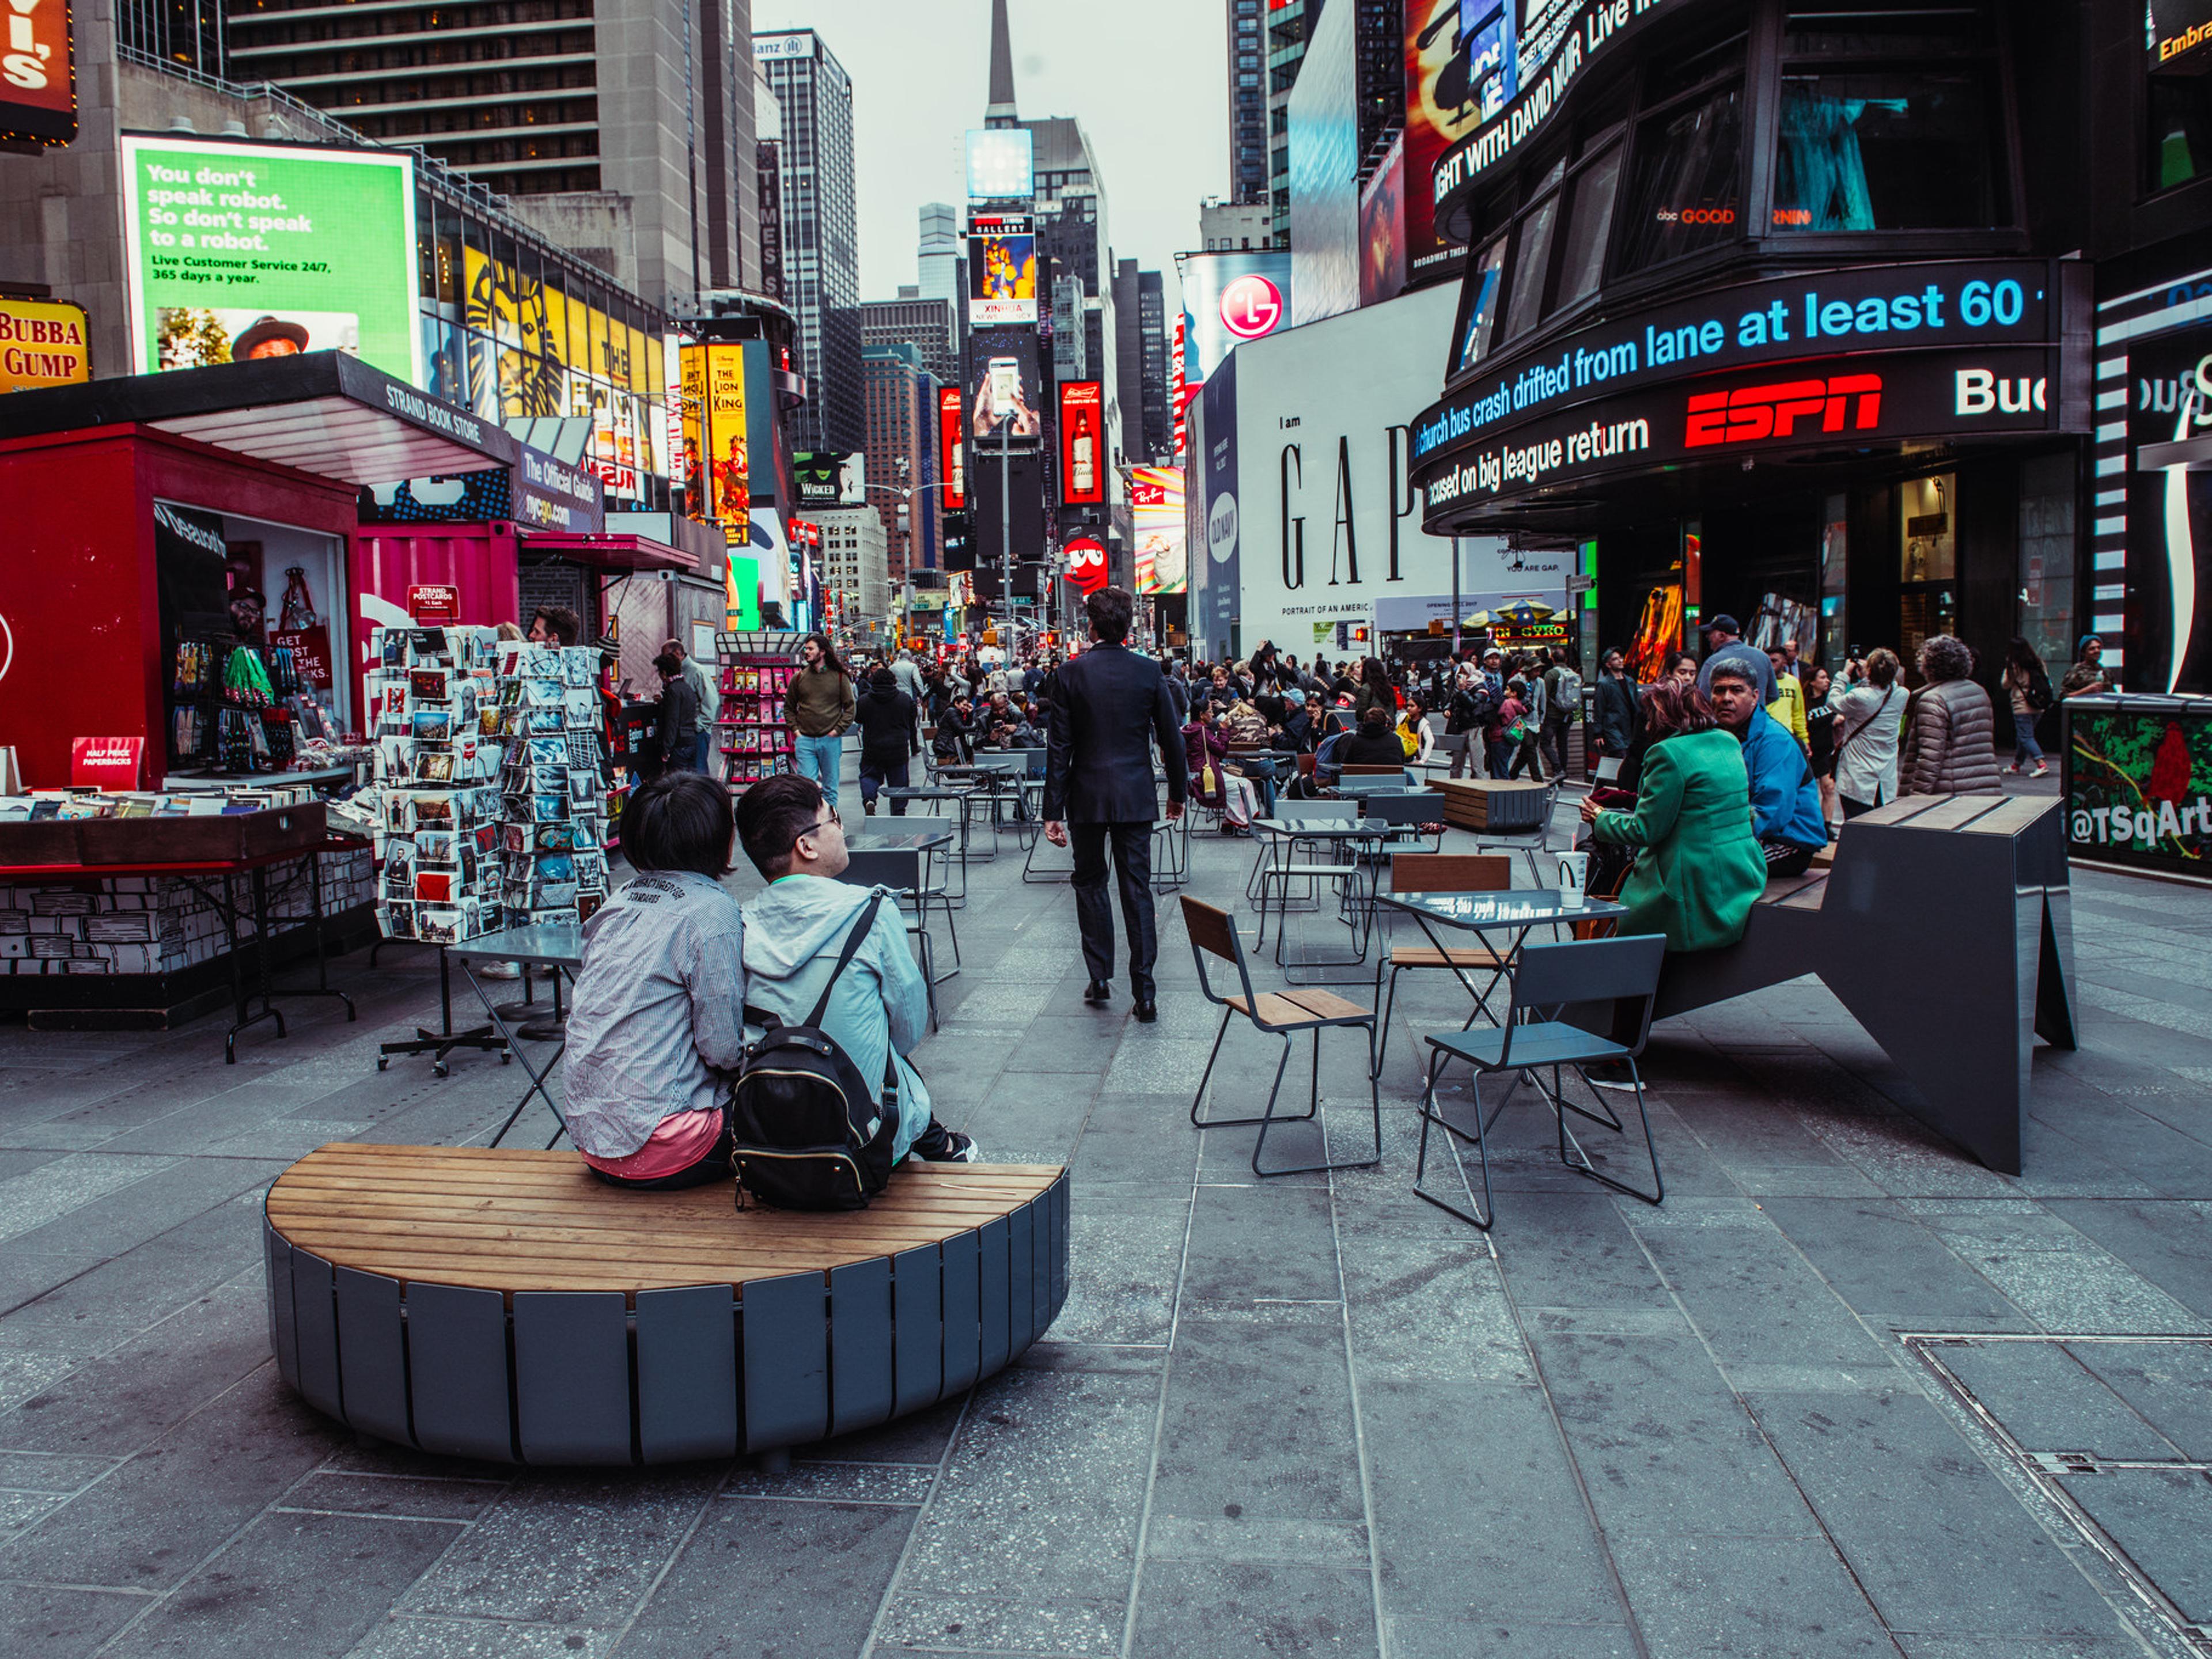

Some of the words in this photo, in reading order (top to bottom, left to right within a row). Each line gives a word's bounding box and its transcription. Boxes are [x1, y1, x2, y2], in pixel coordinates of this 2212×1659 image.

[752, 41, 780, 55] ianz
[1465, 119, 1509, 177] WITH
[1512, 77, 1552, 146] DAVID
[1552, 31, 1581, 102] MUIR
[1588, 0, 1630, 54] Live
[147, 164, 190, 184] You
[196, 166, 256, 188] don't
[147, 187, 214, 208] speak
[219, 190, 287, 211] robot.
[148, 208, 176, 225] So
[183, 209, 243, 229] don't
[249, 214, 312, 234] speak
[759, 169, 777, 265] TIMES
[1682, 209, 1735, 224] GOOD
[976, 225, 1025, 233] GALLERY
[149, 229, 174, 248] to
[181, 233, 195, 248] a
[201, 231, 269, 251] robot.
[152, 255, 179, 267] Live
[184, 256, 248, 270] Customer
[251, 259, 298, 272] Service
[1414, 249, 1448, 268] BROADWAY
[153, 269, 176, 280] 365
[180, 269, 211, 284] days
[215, 273, 224, 282] a
[226, 272, 260, 286] year.
[0, 313, 82, 345] BUBBA
[5, 347, 77, 377] GUMP
[1419, 413, 1449, 454] church
[1449, 408, 1471, 440] bus
[1472, 382, 1510, 428] crash
[1513, 354, 1570, 411] drifted
[1575, 342, 1637, 388] from
[1647, 319, 1724, 368] lane
[1738, 300, 1789, 347] at
[1806, 285, 1945, 338] least
[1960, 279, 2024, 326] 60
[717, 370, 733, 378] THE
[714, 381, 738, 394] LION
[714, 396, 743, 412] KING
[1685, 373, 1883, 448] ESPN
[385, 384, 426, 421] STRAND
[428, 400, 453, 431] BOOK
[453, 414, 482, 445] STORE
[1279, 416, 1283, 429] I
[1285, 417, 1301, 429] am
[1461, 467, 1476, 494] on
[1479, 452, 1500, 492] big
[1503, 439, 1562, 483] league
[1567, 418, 1650, 464] return
[525, 453, 543, 484] The
[543, 462, 573, 498] Official
[574, 476, 594, 504] Guide
[802, 483, 836, 495] WICKED
[527, 495, 570, 526] nycgo.com
[1280, 425, 1415, 590] GAP
[1221, 510, 1234, 540] NAVY
[1282, 605, 1316, 615] PORTRAIT
[1317, 604, 1326, 613] OF
[1327, 604, 1339, 613] AN
[277, 635, 301, 645] GET
[1521, 625, 1565, 637] GYRO
[298, 657, 320, 667] THE
[83, 757, 131, 766] PAPERBACKS
[107, 749, 130, 757] PRICE
